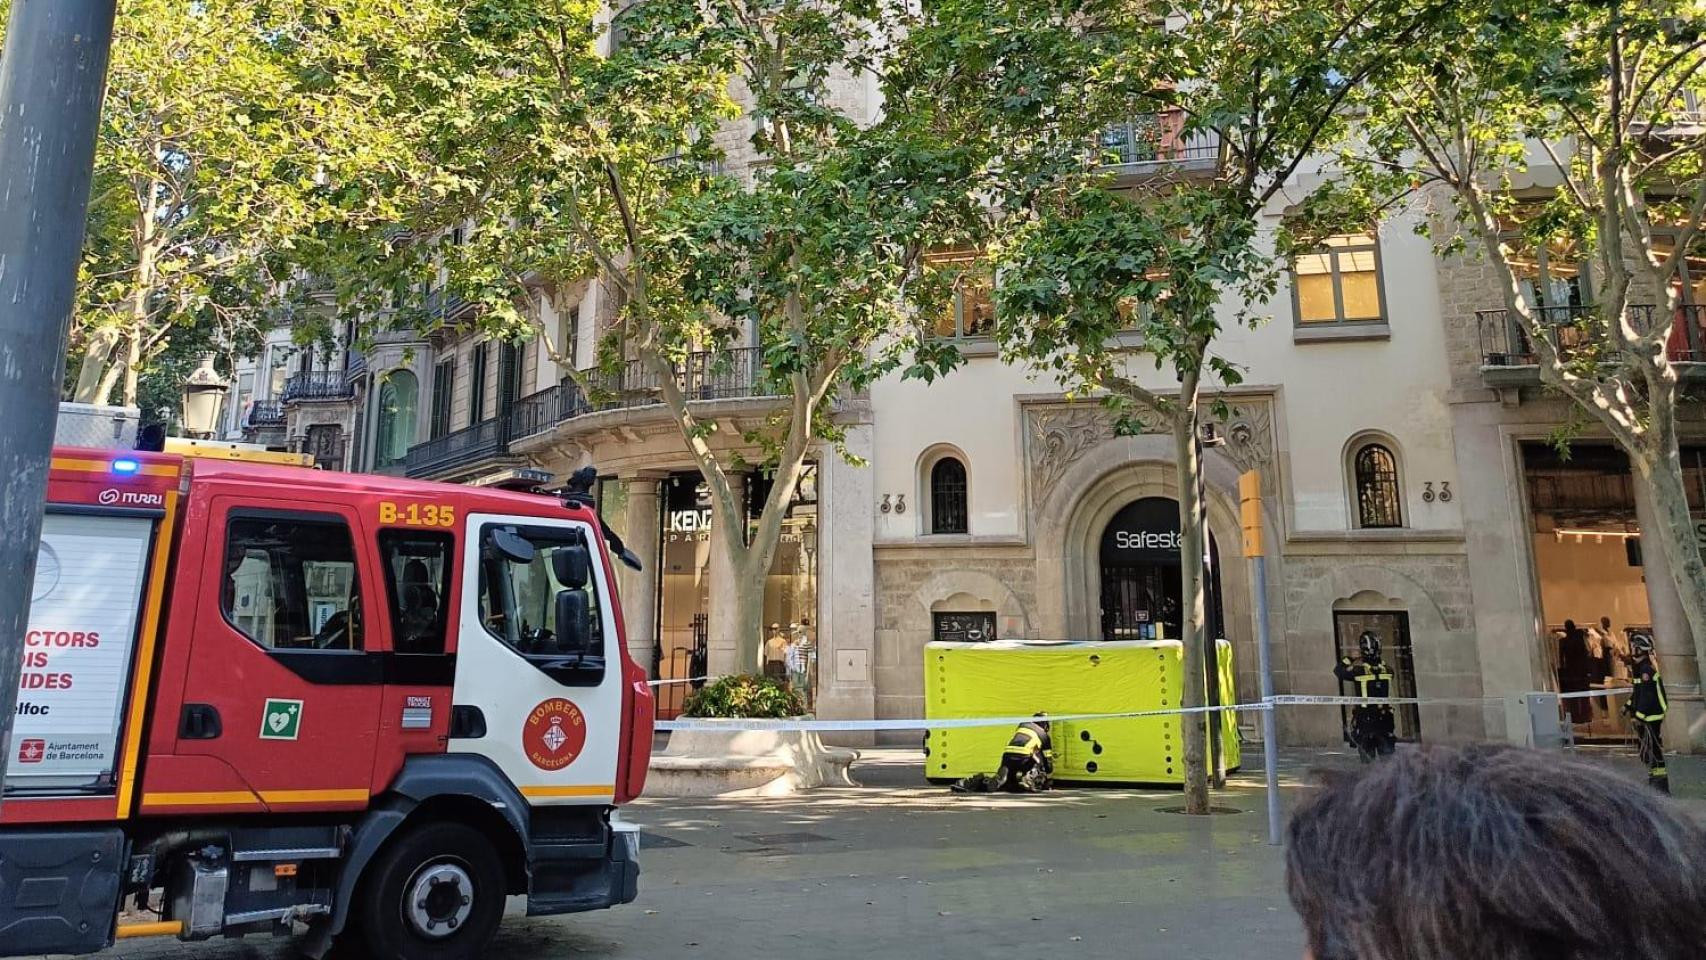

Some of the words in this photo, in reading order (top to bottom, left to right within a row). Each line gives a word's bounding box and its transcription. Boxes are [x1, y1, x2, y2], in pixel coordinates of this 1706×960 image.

[122, 492, 162, 504] ITURRI
[379, 501, 455, 527] B-135
[670, 509, 712, 532] KENZ
[670, 533, 711, 542] PAR
[25, 631, 99, 648] CTORS
[22, 652, 48, 668] IS
[21, 673, 73, 689] IDES
[529, 701, 582, 726] BOMBERS
[48, 742, 99, 752] Ajuntament
[46, 752, 58, 760] de
[59, 752, 105, 760] Barcelona
